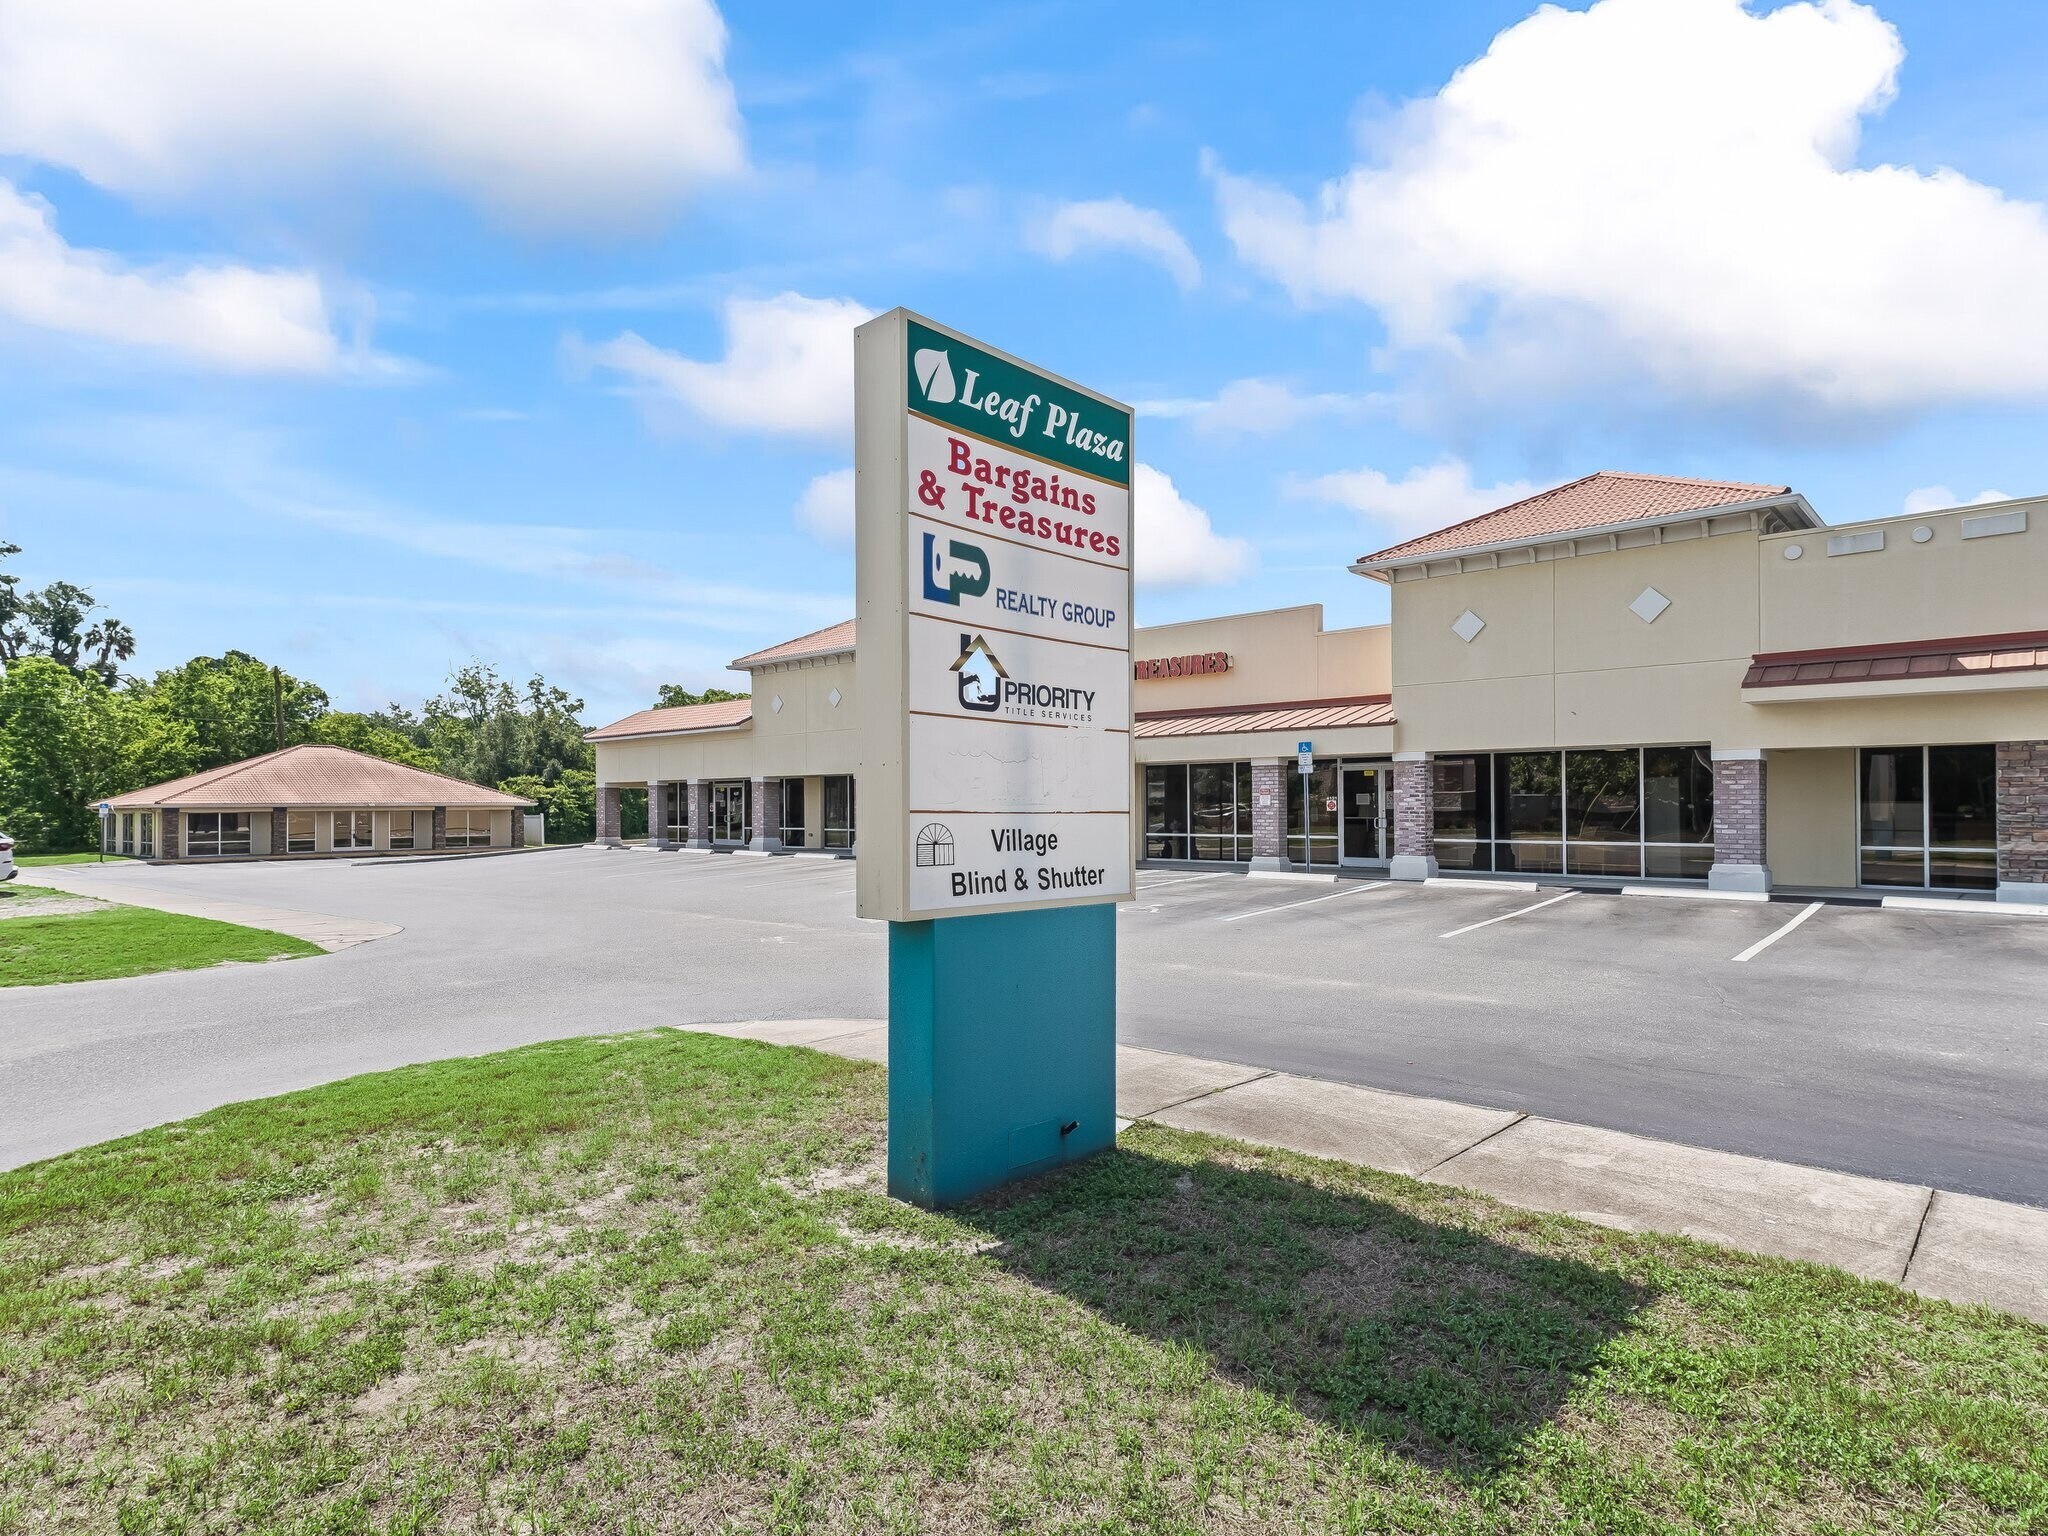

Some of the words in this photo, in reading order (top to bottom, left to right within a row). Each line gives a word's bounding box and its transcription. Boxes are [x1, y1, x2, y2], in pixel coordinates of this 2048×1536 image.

[958, 368, 1041, 438] Leaf
[1042, 402, 1125, 462] Plaza
[947, 436, 1097, 516] Bargains
[917, 469, 946, 511] &
[961, 482, 1121, 557] Treasures
[995, 587, 1058, 619] REALTY
[1062, 601, 1116, 629] GROUP
[1134, 651, 1229, 681] REASURES
[1004, 680, 1096, 712] PRIORITY
[1005, 706, 1035, 717] TITLE
[1041, 710, 1093, 723] SERVICES
[991, 828, 1059, 857] Village
[951, 869, 1008, 897] Blind
[1013, 867, 1029, 892] &
[1037, 867, 1106, 892] Shutter
